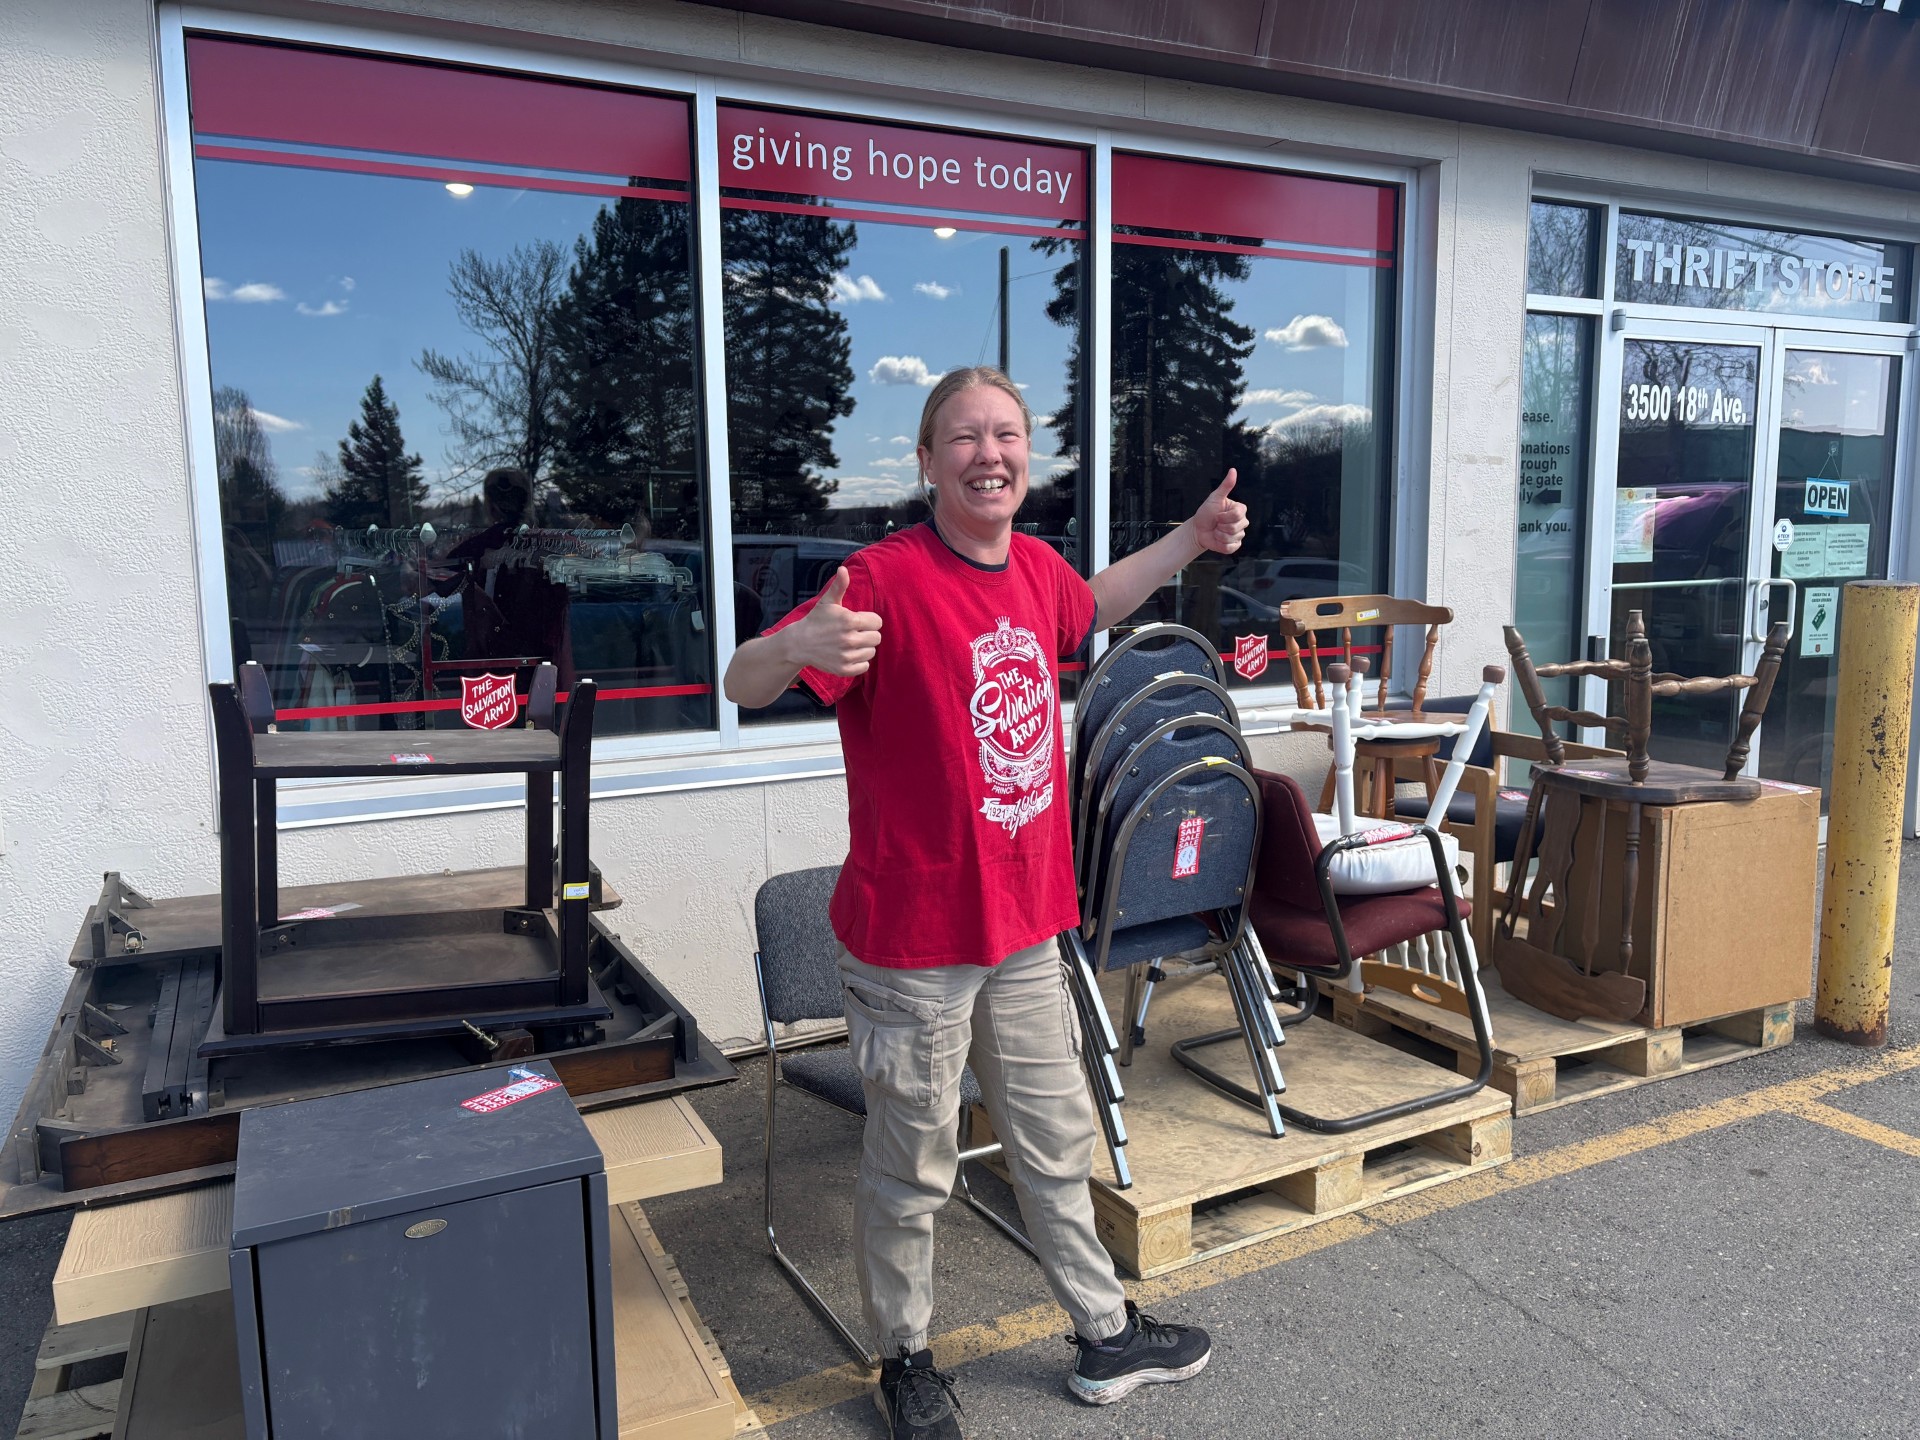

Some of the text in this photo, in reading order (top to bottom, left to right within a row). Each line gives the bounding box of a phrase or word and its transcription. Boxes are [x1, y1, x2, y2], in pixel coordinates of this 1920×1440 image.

[732, 127, 1072, 204] giving hope today
[1627, 239, 1895, 304] THRIFT STORE
[1627, 383, 1747, 424] 3500 18th Ave.
[1536, 474, 1563, 488] gate
[1519, 488, 1533, 504] ly
[1807, 483, 1848, 511] OPEN
[1518, 520, 1571, 535] ank you.
[1236, 640, 1265, 669] SALVATION
[1241, 638, 1255, 653] THE
[1247, 653, 1265, 674] ARMY
[471, 678, 493, 699] THE
[996, 667, 1022, 690] THE
[465, 681, 511, 719] SALVATION
[483, 698, 511, 725] ARMY
[1009, 712, 1043, 750] ARMY
[992, 784, 1016, 794] PRINCE
[990, 807, 1006, 819] 1921
[1014, 789, 1039, 817] 100
[1180, 818, 1202, 829] SALE
[1180, 826, 1201, 836] SALE
[1180, 833, 1200, 843] SALE
[1175, 866, 1196, 877] SALE
